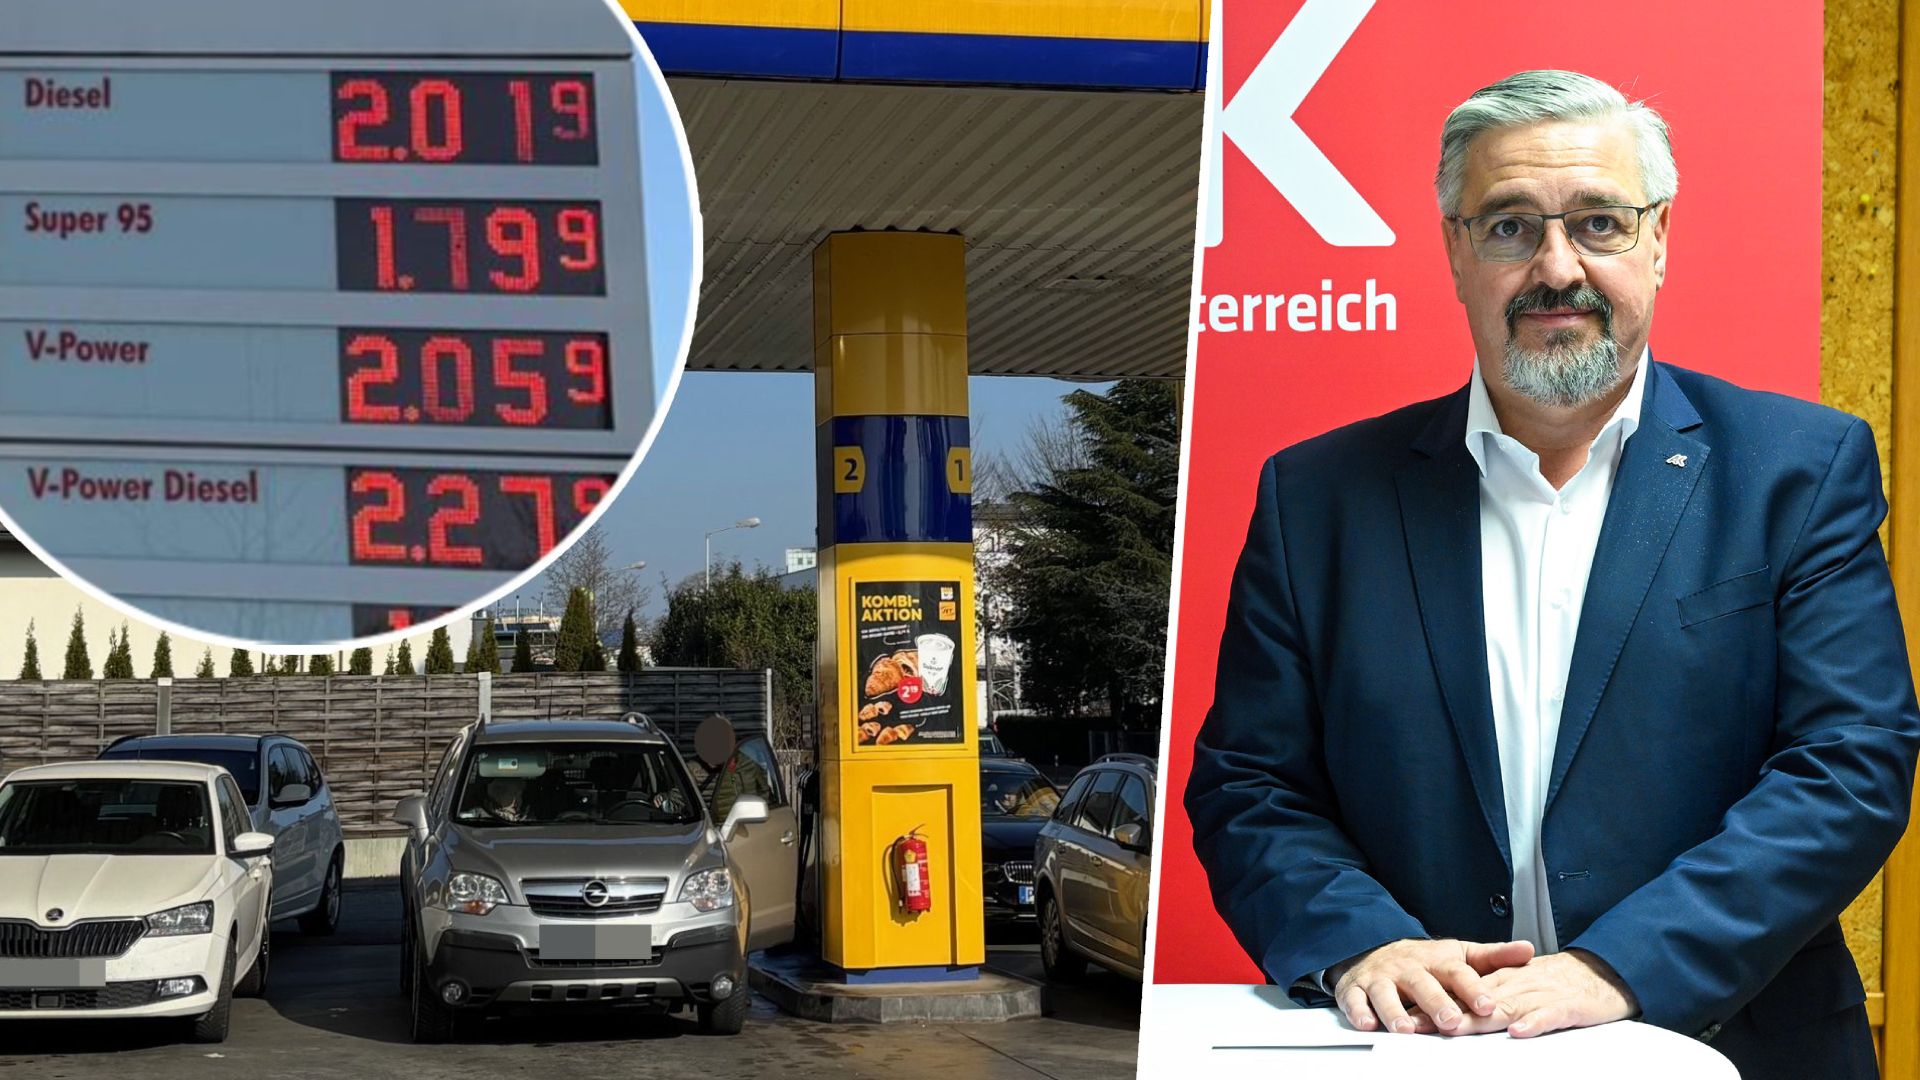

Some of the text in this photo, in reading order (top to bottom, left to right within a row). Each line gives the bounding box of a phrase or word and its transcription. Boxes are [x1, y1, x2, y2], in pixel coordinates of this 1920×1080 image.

[24, 77, 111, 109] Diesel
[24, 201, 152, 239] Super 95
[370, 206, 598, 291] 1.799
[24, 329, 149, 363] V-Power
[346, 335, 608, 425] 2.059
[27, 467, 259, 502] V-Power Diesel
[844, 458, 859, 481] 2
[954, 459, 963, 481] 1
[861, 595, 920, 609] KOMBI-
[861, 608, 923, 622] AKTION
